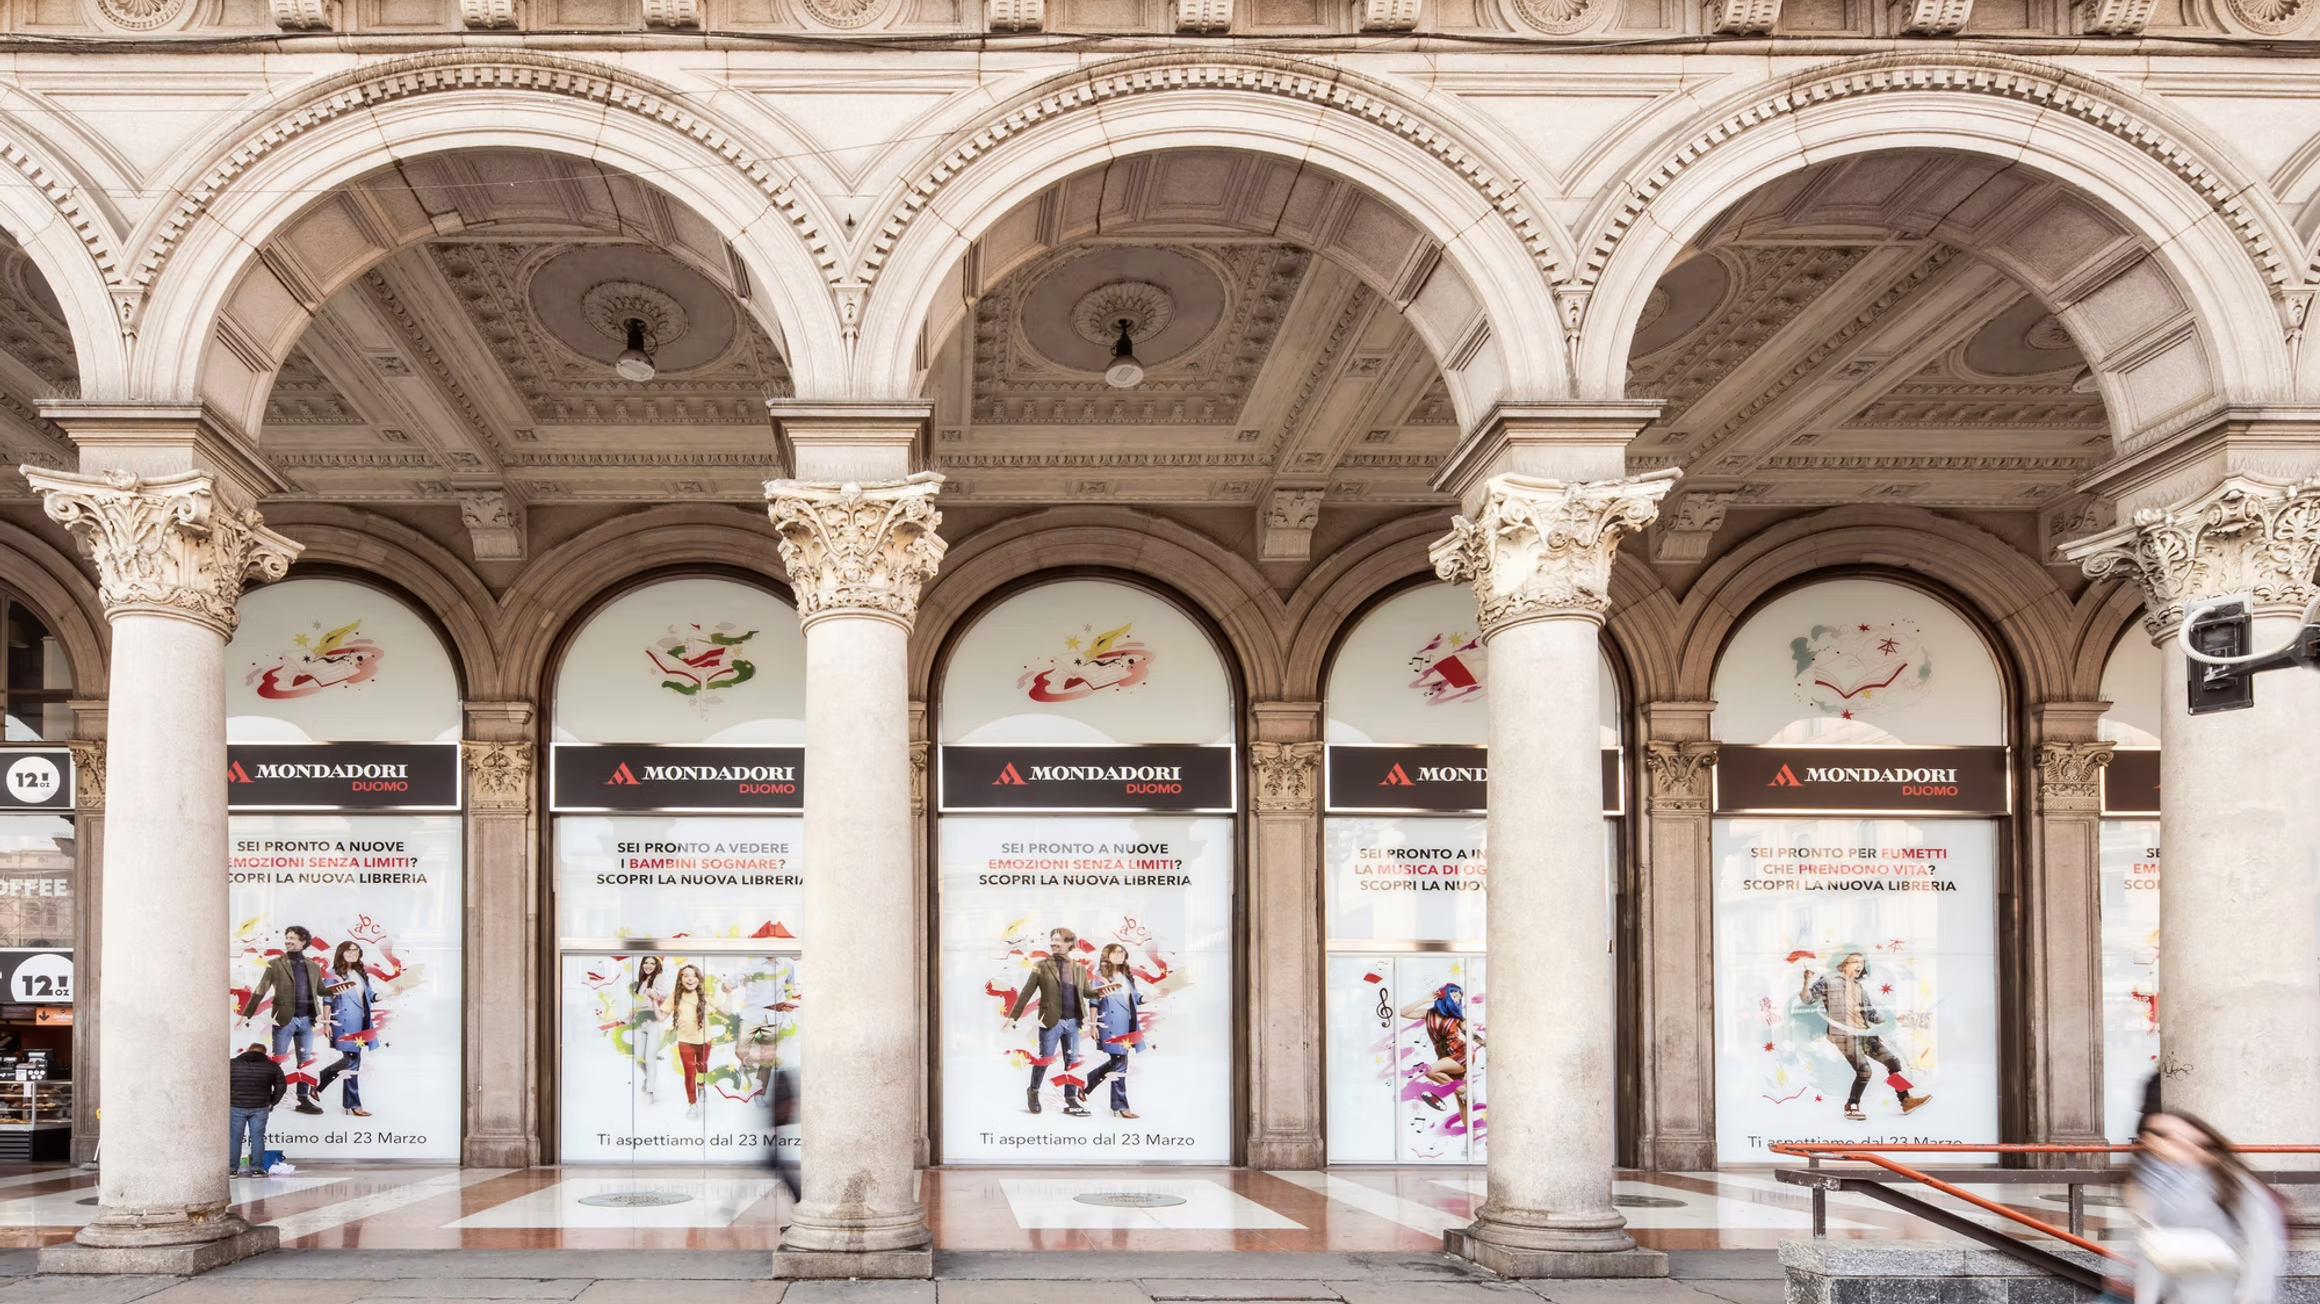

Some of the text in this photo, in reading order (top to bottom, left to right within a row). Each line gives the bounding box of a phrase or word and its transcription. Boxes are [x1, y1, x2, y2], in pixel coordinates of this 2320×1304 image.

[254, 764, 408, 778] MONDADORI
[642, 766, 796, 780] MONDADORI
[1029, 766, 1182, 780] MONDADORI
[1416, 767, 1487, 782] MOND
[1804, 768, 1958, 782] MONDADORI
[352, 781, 408, 792] DUOMO
[739, 784, 796, 794] DUOMO
[1126, 784, 1182, 794] DUOMO
[1902, 786, 1958, 796] DUOMO
[237, 841, 404, 852] SEI PRONTO A NUOVE
[617, 842, 789, 854] SEI PRONTO A VEDERE
[1002, 843, 1168, 854] SEI PRONTO A NUOVE
[1360, 848, 1382, 859] SEI
[1387, 848, 1452, 859] PRONTO
[1456, 848, 1468, 859] A
[1750, 848, 1948, 858] SEI PRONTO PER FUMETTI
[309, 857, 360, 868] SENZA
[364, 857, 418, 868] LIMITI?
[621, 859, 786, 869] I BAMBINI SOGNARE?
[989, 860, 1182, 870] EMOZIONI SENZA LIMITI?
[1355, 865, 1373, 875] LA
[1378, 865, 1438, 875] MUSICA
[1443, 865, 1458, 875] DI
[1763, 864, 1936, 875] CHE PRENDONO VITA?
[2134, 864, 2160, 874] EM
[276, 873, 294, 884] LA
[299, 873, 355, 884] NUOVA
[360, 873, 428, 884] LIBRERIA
[596, 874, 653, 885] SCOPRI
[658, 874, 676, 885] LA
[681, 874, 738, 885] NUOVA
[979, 875, 1192, 886] SCOPRI LA NUOVA LIBRERIA
[1360, 880, 1416, 891] SCOPRI
[1422, 880, 1440, 891] LA
[1744, 880, 1957, 891] SCOPRI LA NUOVA LIBRERIA
[2124, 880, 2160, 890] SCO
[324, 1132, 348, 1144] dal
[354, 1132, 372, 1144] 23
[378, 1132, 427, 1144] Marzo
[597, 1134, 611, 1146] Ti
[616, 1134, 704, 1150] aspettiamo
[710, 1134, 733, 1146] dal
[738, 1134, 757, 1146] 23
[980, 1133, 1195, 1148] Ti aspettiamo dal 23 Marzo
[1748, 1136, 1761, 1148] Ti
